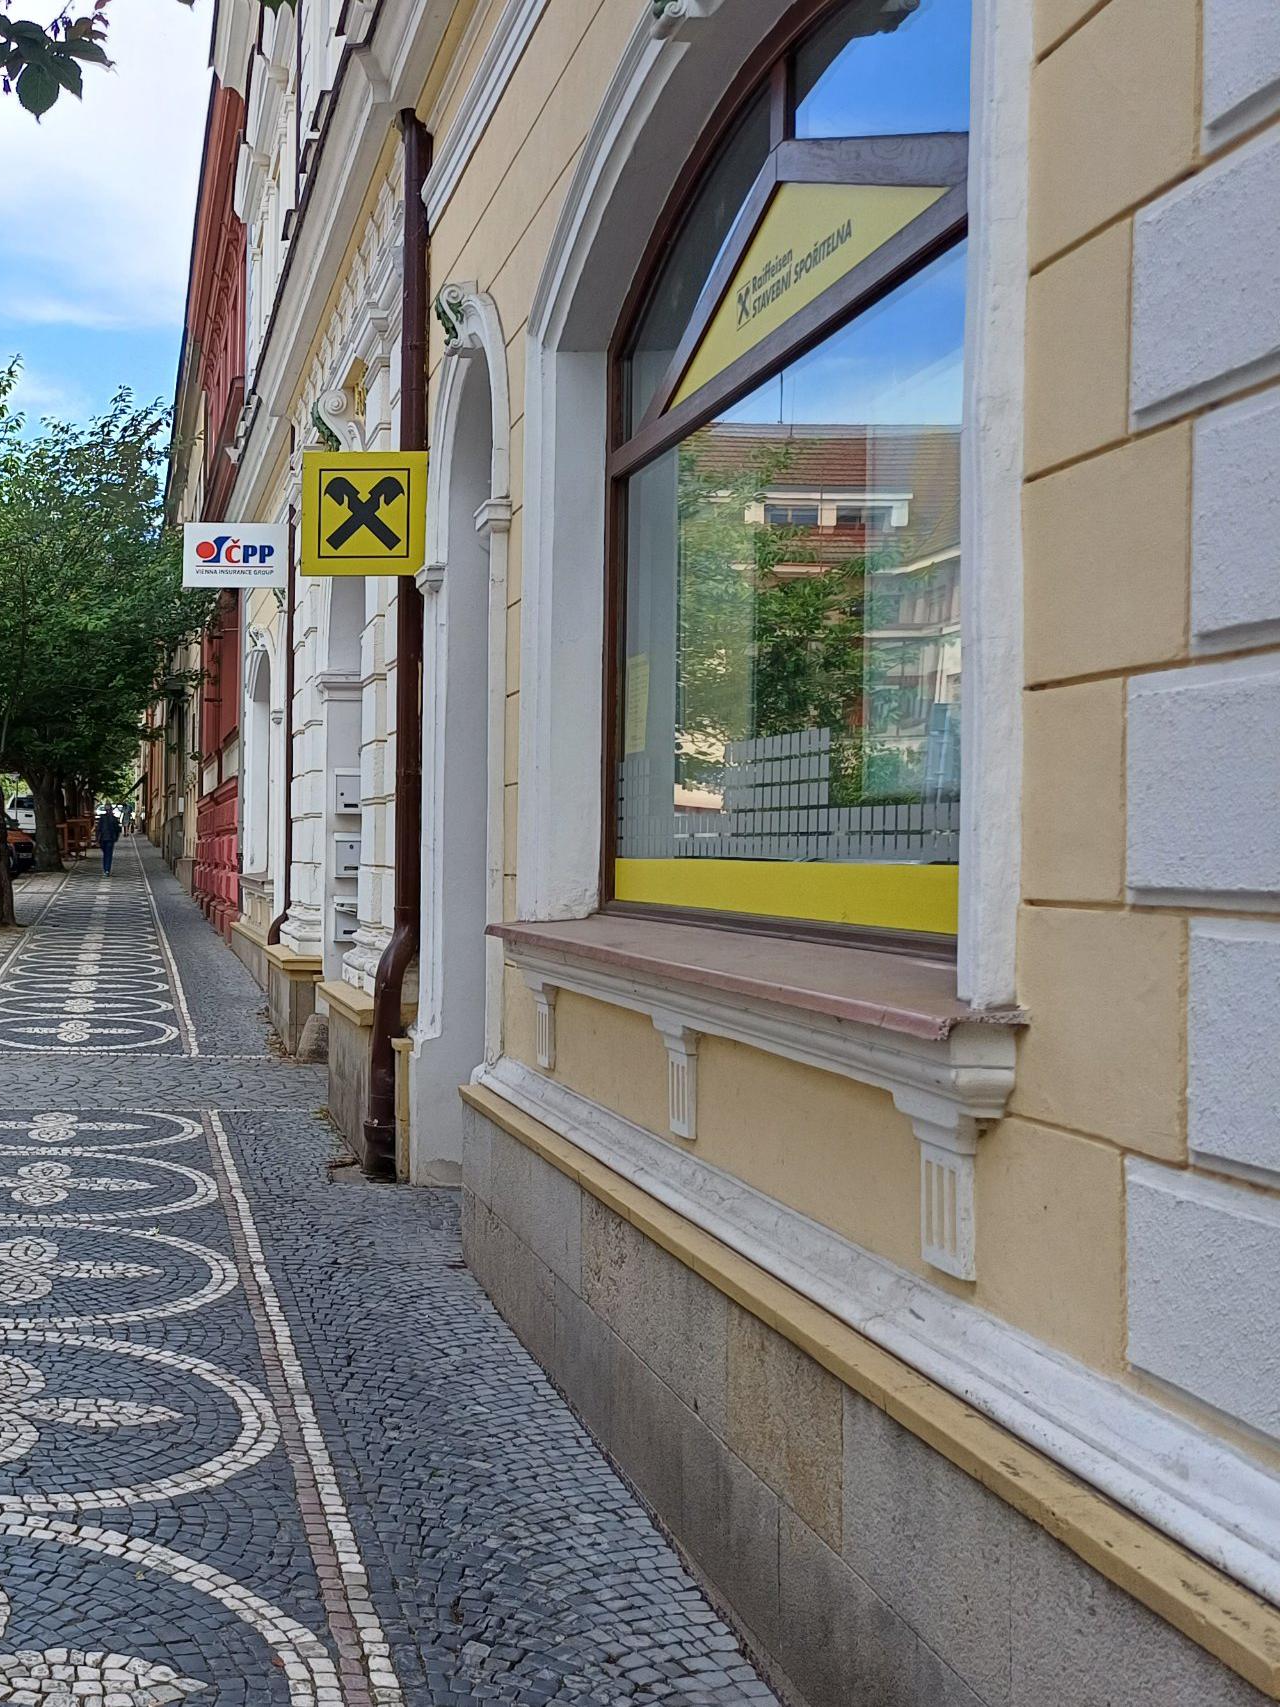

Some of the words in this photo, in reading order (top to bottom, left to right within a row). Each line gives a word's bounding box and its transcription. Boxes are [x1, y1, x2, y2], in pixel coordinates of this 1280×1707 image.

[751, 263, 793, 318] STAVEBNÍ
[793, 218, 852, 284] SPOŘITELNA
[751, 248, 793, 294] Raiffeisen
[225, 538, 275, 564] ČPP
